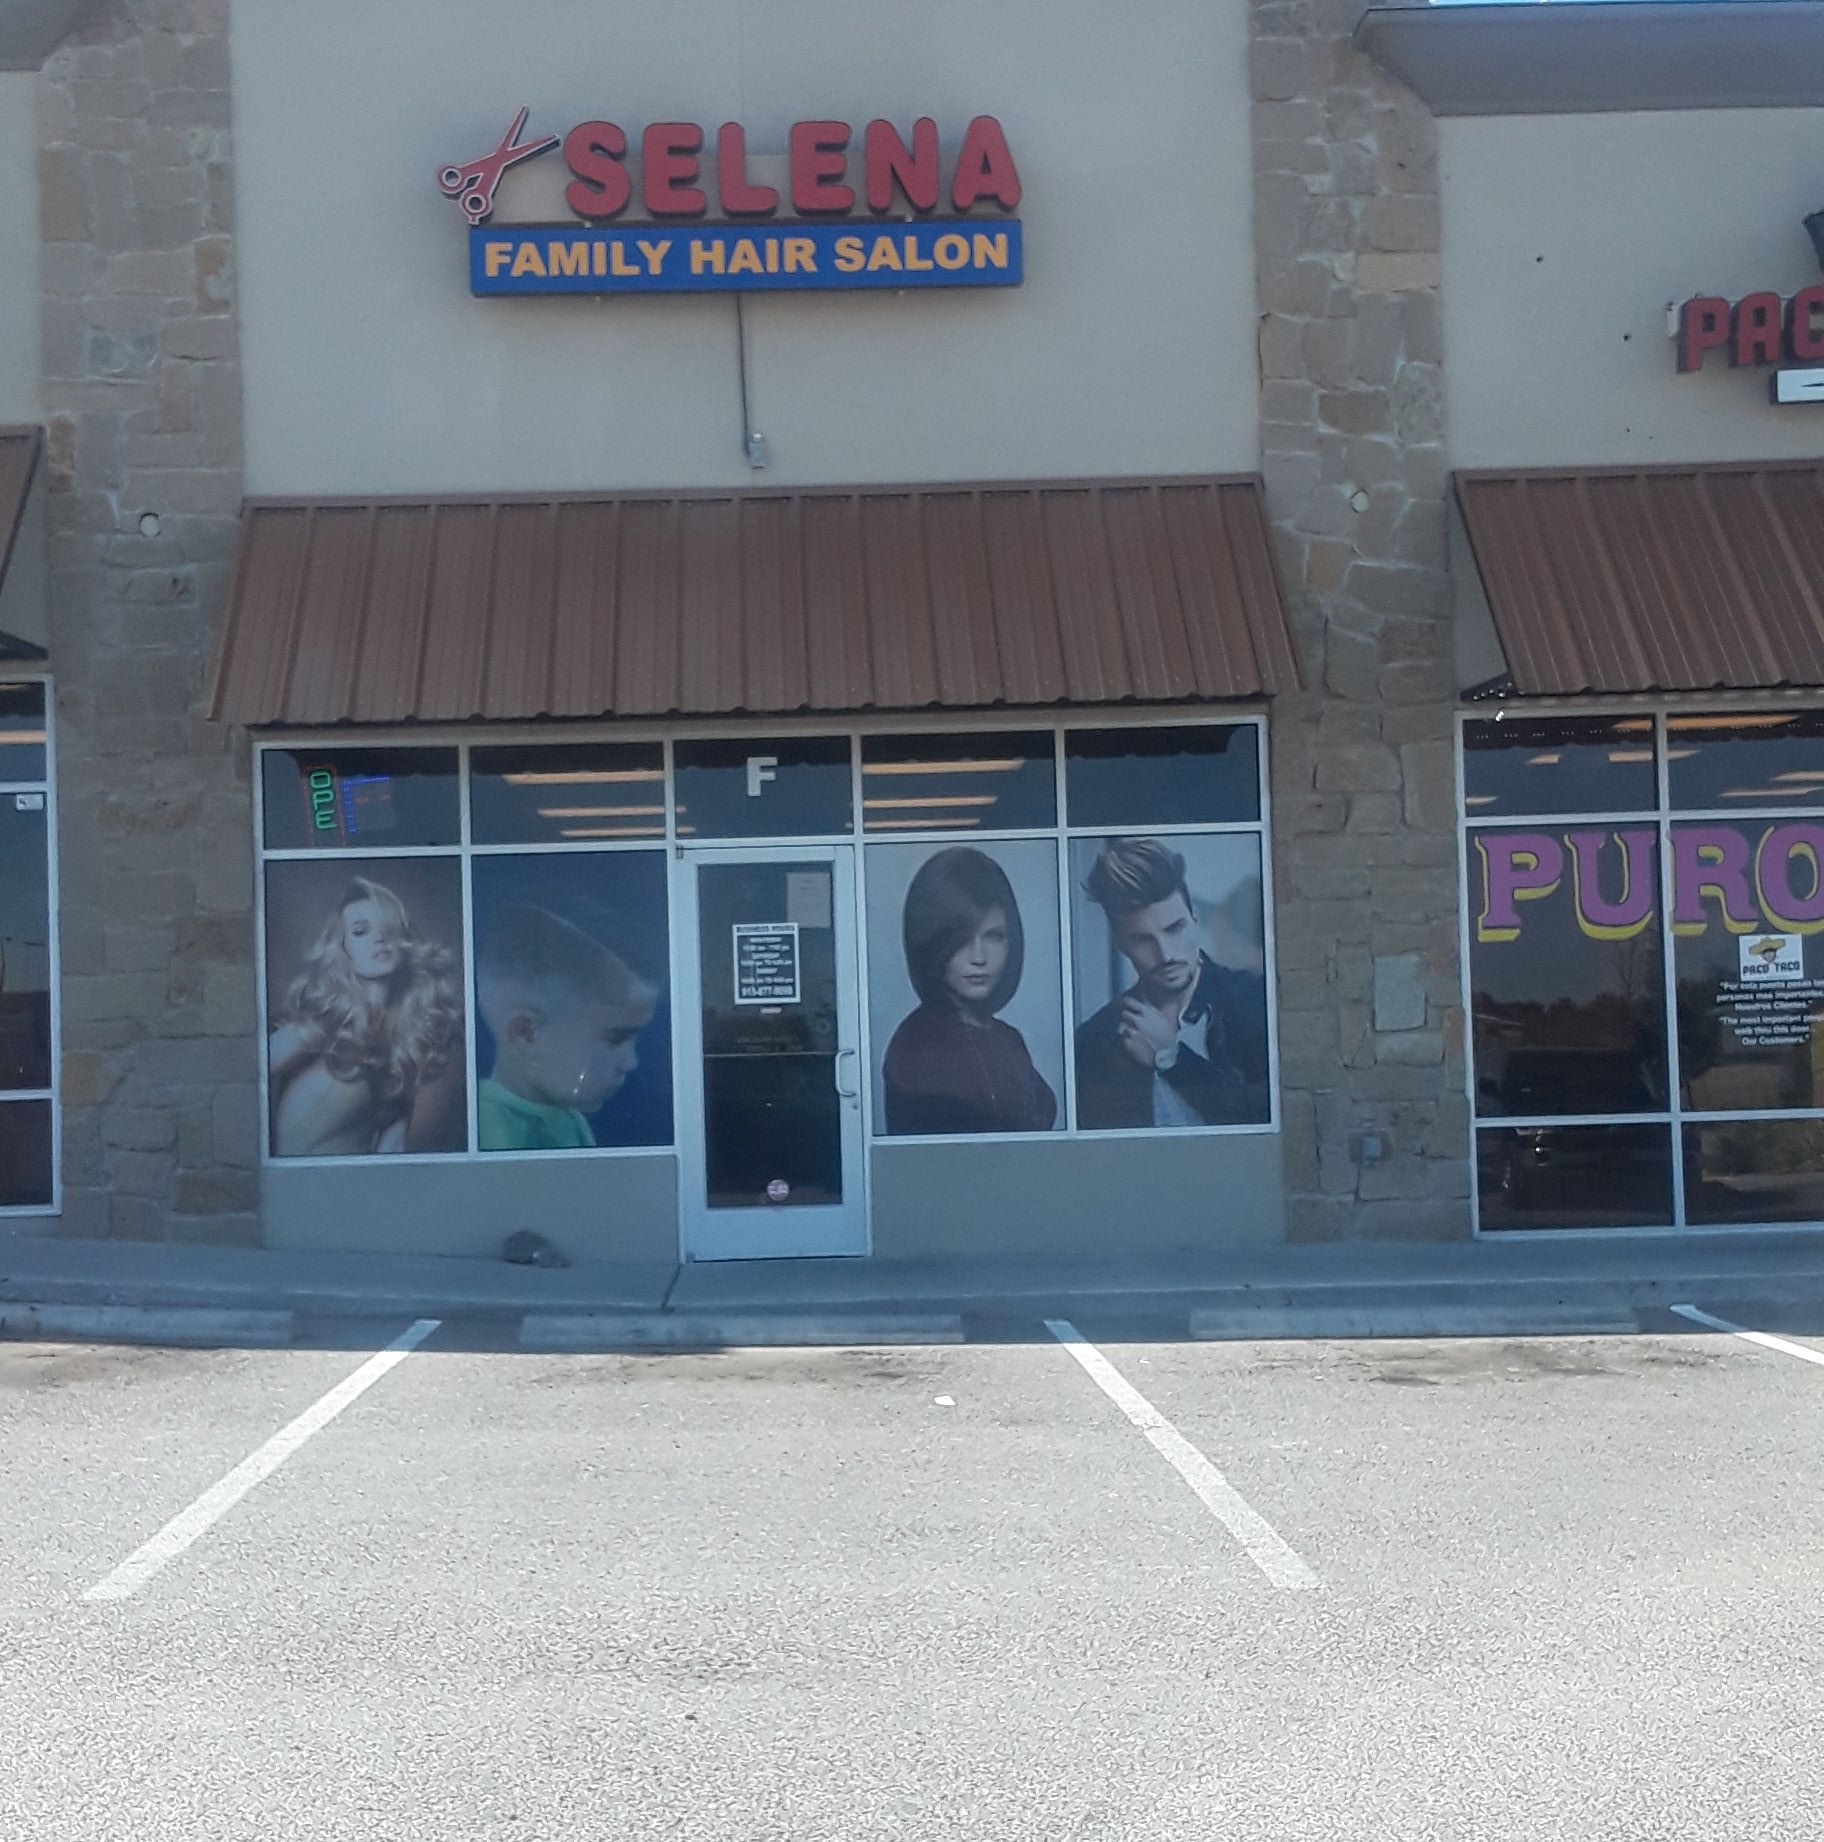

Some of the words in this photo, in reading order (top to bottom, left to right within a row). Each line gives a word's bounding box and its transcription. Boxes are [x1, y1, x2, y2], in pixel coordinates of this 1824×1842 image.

[563, 114, 1021, 218] SELENA
[484, 240, 672, 278] FAMILY
[690, 238, 817, 275] HAIR
[835, 233, 1009, 273] SALON
[309, 769, 338, 831] OPE
[747, 756, 778, 797] F
[1474, 823, 1824, 942] PURO
[1743, 963, 1770, 975] PACO
[1774, 961, 1800, 973] TACO
